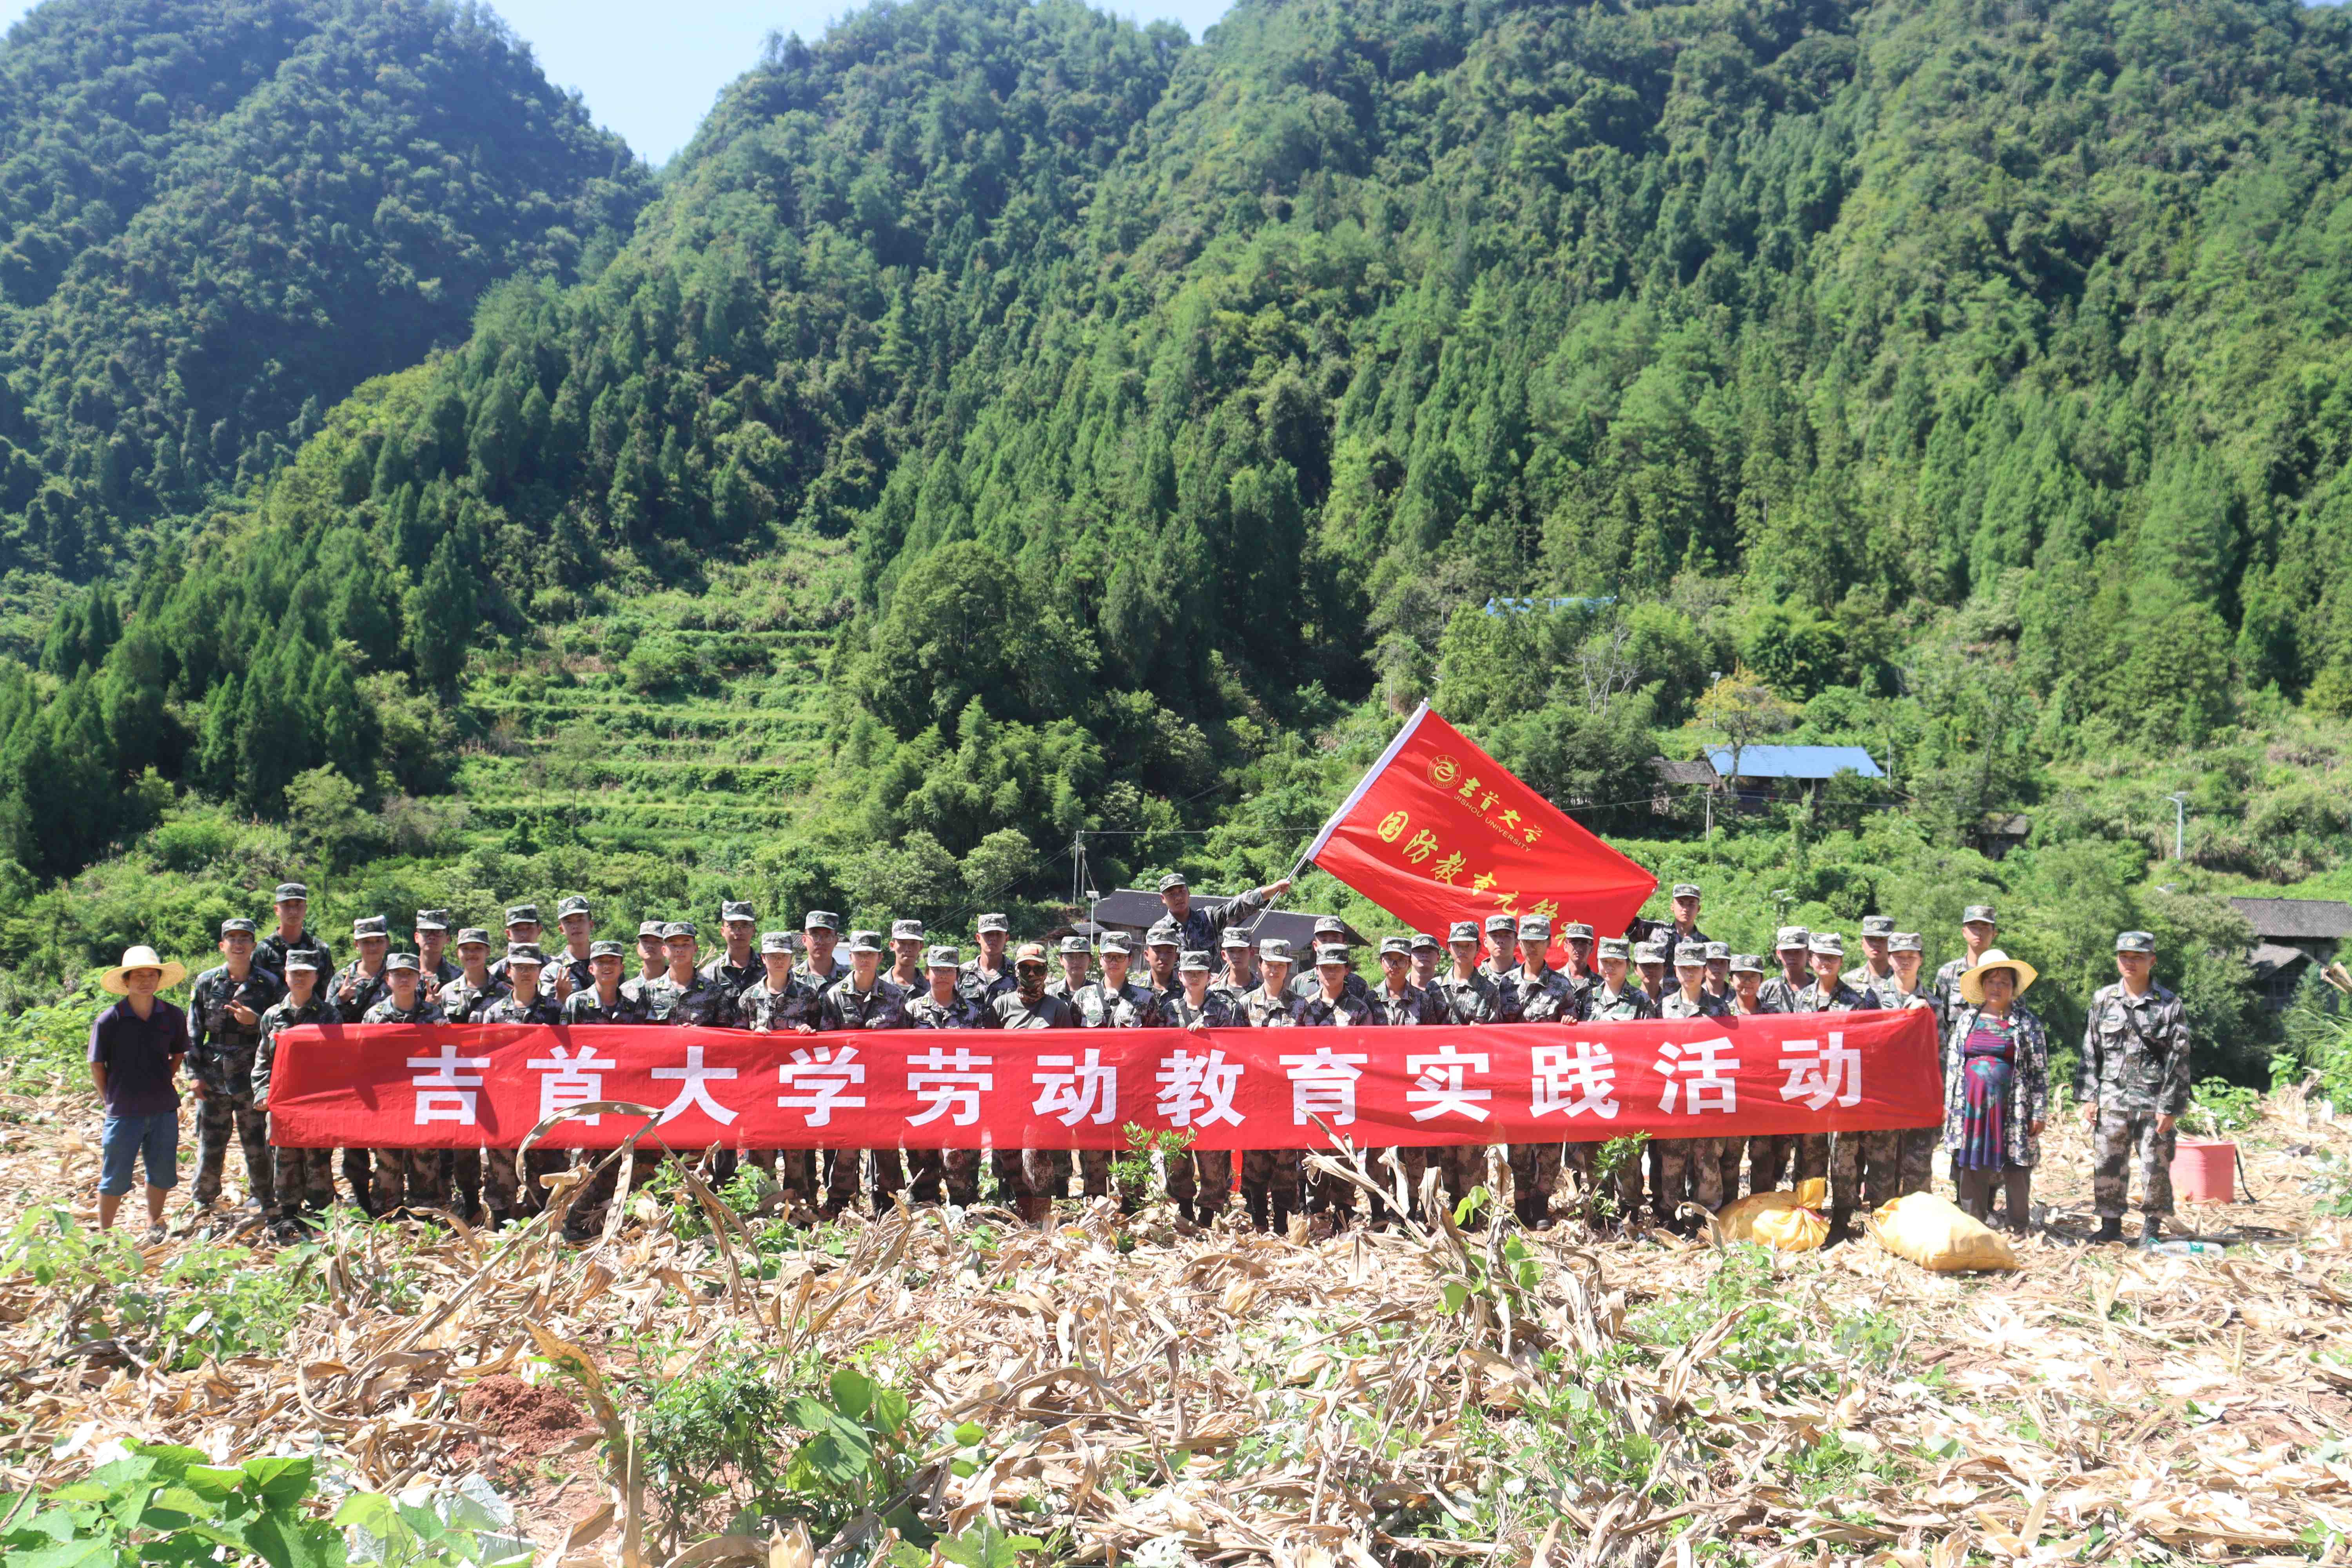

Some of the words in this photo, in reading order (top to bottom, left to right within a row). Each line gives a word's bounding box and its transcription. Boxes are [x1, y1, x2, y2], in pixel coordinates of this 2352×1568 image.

[1454, 795, 1483, 817] JISHOU
[1485, 817, 1531, 852] UNIVERSITY
[1458, 777, 1543, 843] 吉首大学
[407, 1032, 1861, 1127] 吉首大学劳动教育实践活动
